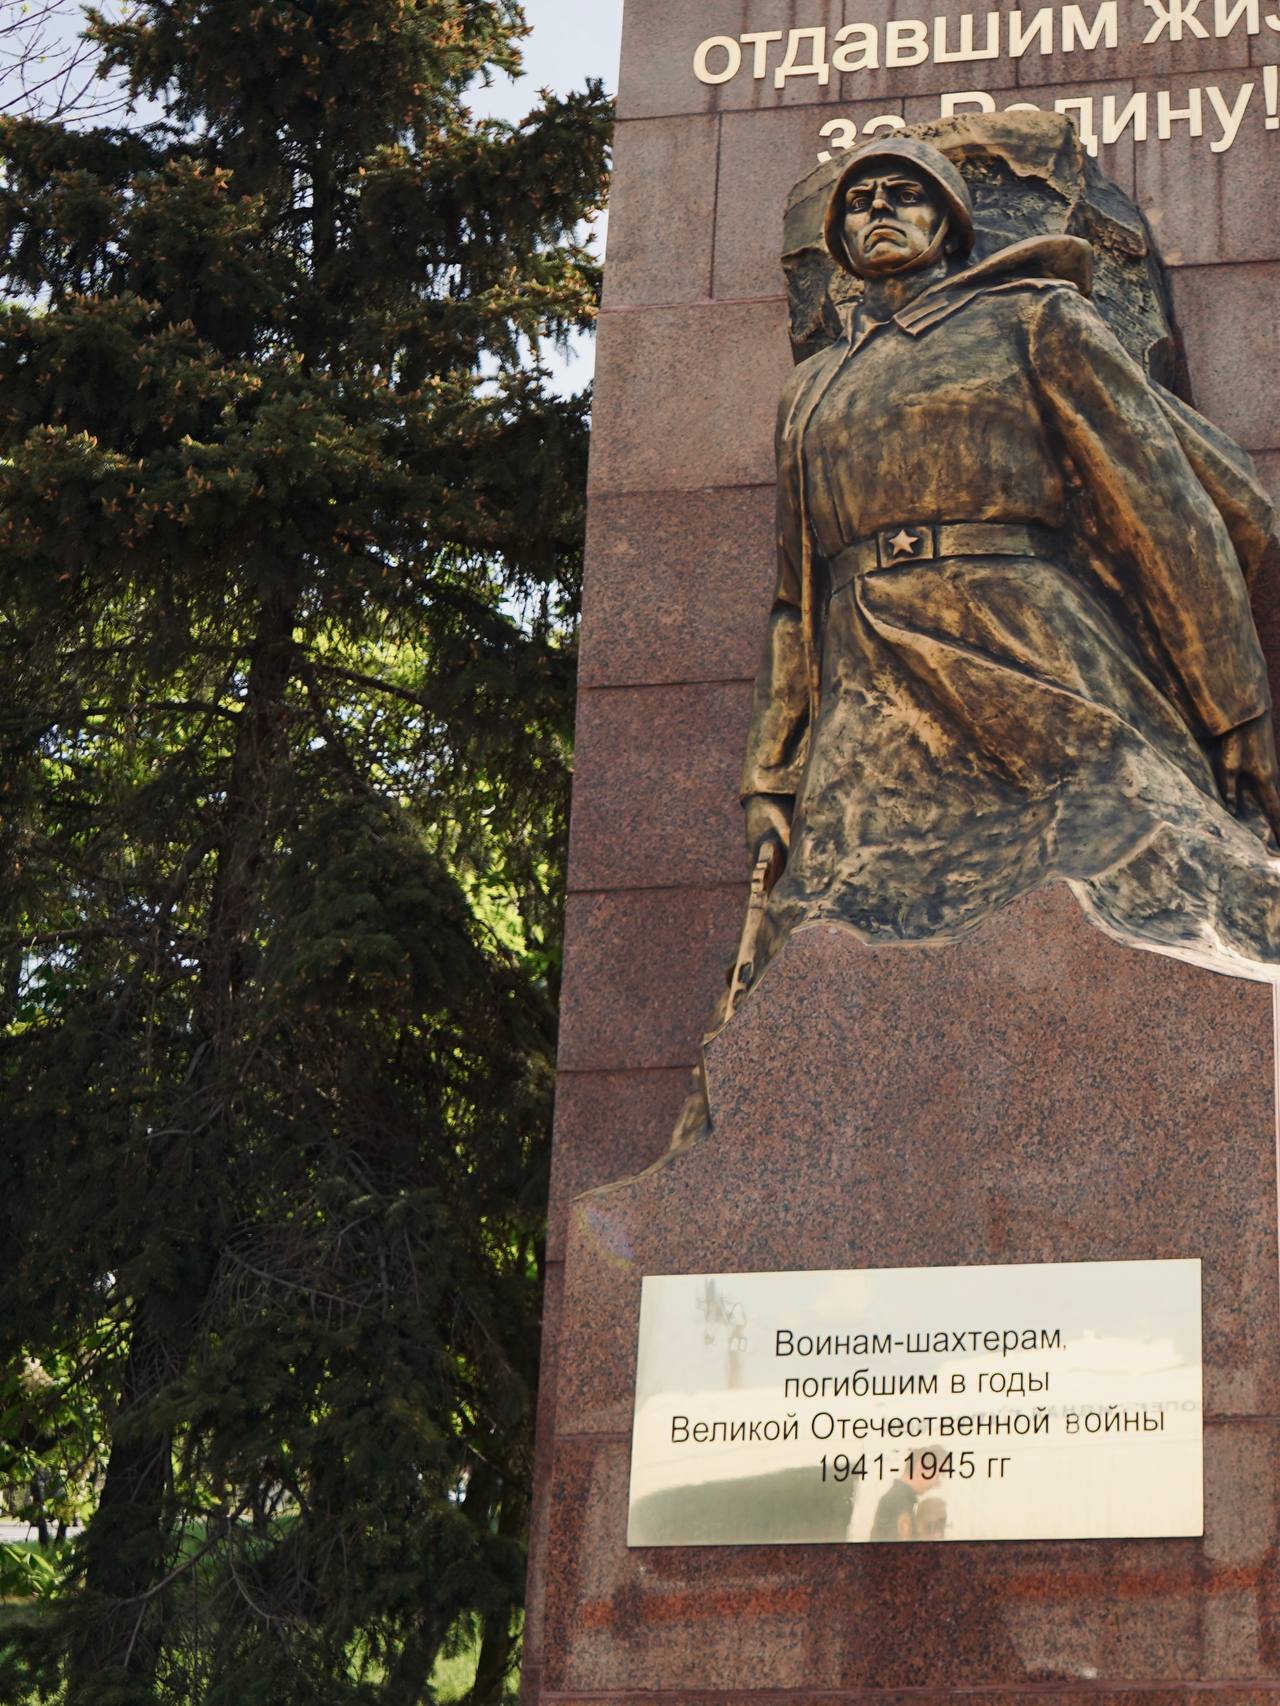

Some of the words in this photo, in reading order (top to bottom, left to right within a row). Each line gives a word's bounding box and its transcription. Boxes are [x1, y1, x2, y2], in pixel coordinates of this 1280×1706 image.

[693, 4, 1118, 89] отдавшим
[940, 65, 1280, 157] дину!
[784, 1368, 937, 1398] погибшим
[951, 1374, 966, 1394] в
[978, 1371, 1049, 1397] годы
[671, 1412, 799, 1443] Великой
[811, 1406, 1049, 1440] Отечественной
[1066, 1404, 1164, 1434] войны
[820, 1451, 975, 1482] 1941-1945
[988, 1457, 1011, 1478] гг
